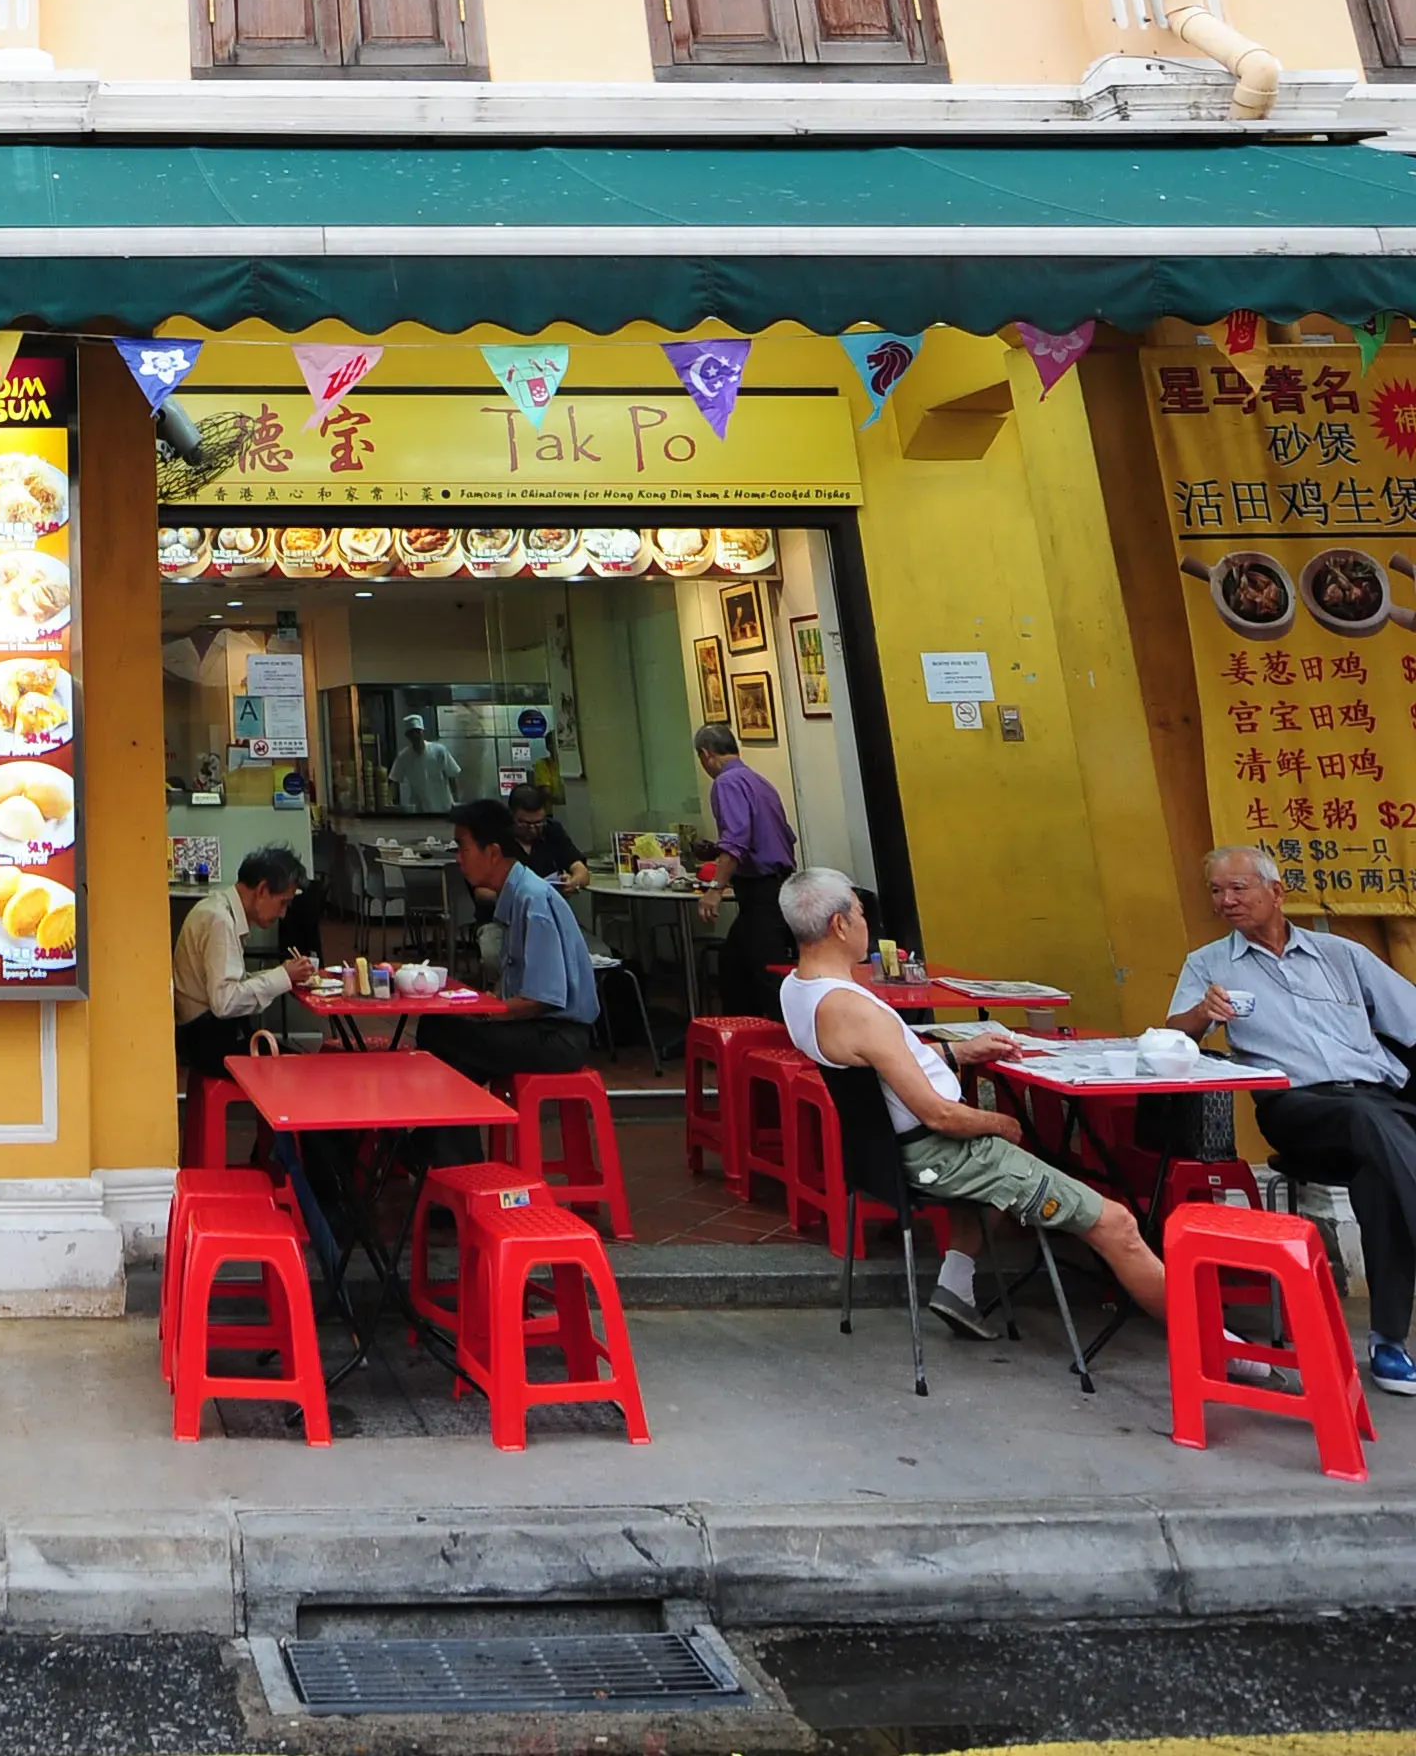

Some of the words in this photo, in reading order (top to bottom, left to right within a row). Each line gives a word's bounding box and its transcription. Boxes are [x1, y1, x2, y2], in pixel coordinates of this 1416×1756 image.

[1159, 365, 1360, 415] 星马著名
[234, 402, 375, 474] 德宝
[480, 405, 601, 472] Tak
[629, 405, 696, 472] Po
[1265, 421, 1361, 468] 砂煲
[459, 489, 503, 500] Famous
[506, 489, 517, 499] in
[520, 489, 580, 499] Chinatown
[583, 489, 600, 501] for
[603, 489, 634, 501] Hong
[637, 489, 667, 501] Kong
[670, 489, 693, 500] Dim
[696, 489, 720, 500] Sum
[734, 489, 811, 501] Home-Cooked
[815, 489, 852, 500] Dishes
[1174, 476, 1416, 528] 活田鸡生煲
[1221, 650, 1367, 686] 姜葱田鸡
[240, 700, 259, 721] A
[1228, 700, 1376, 734] 宫宝田鸡
[1235, 747, 1384, 784] 清鲜田鸡
[1246, 797, 1358, 832] 生煲粥
[1314, 869, 1352, 893] $16
